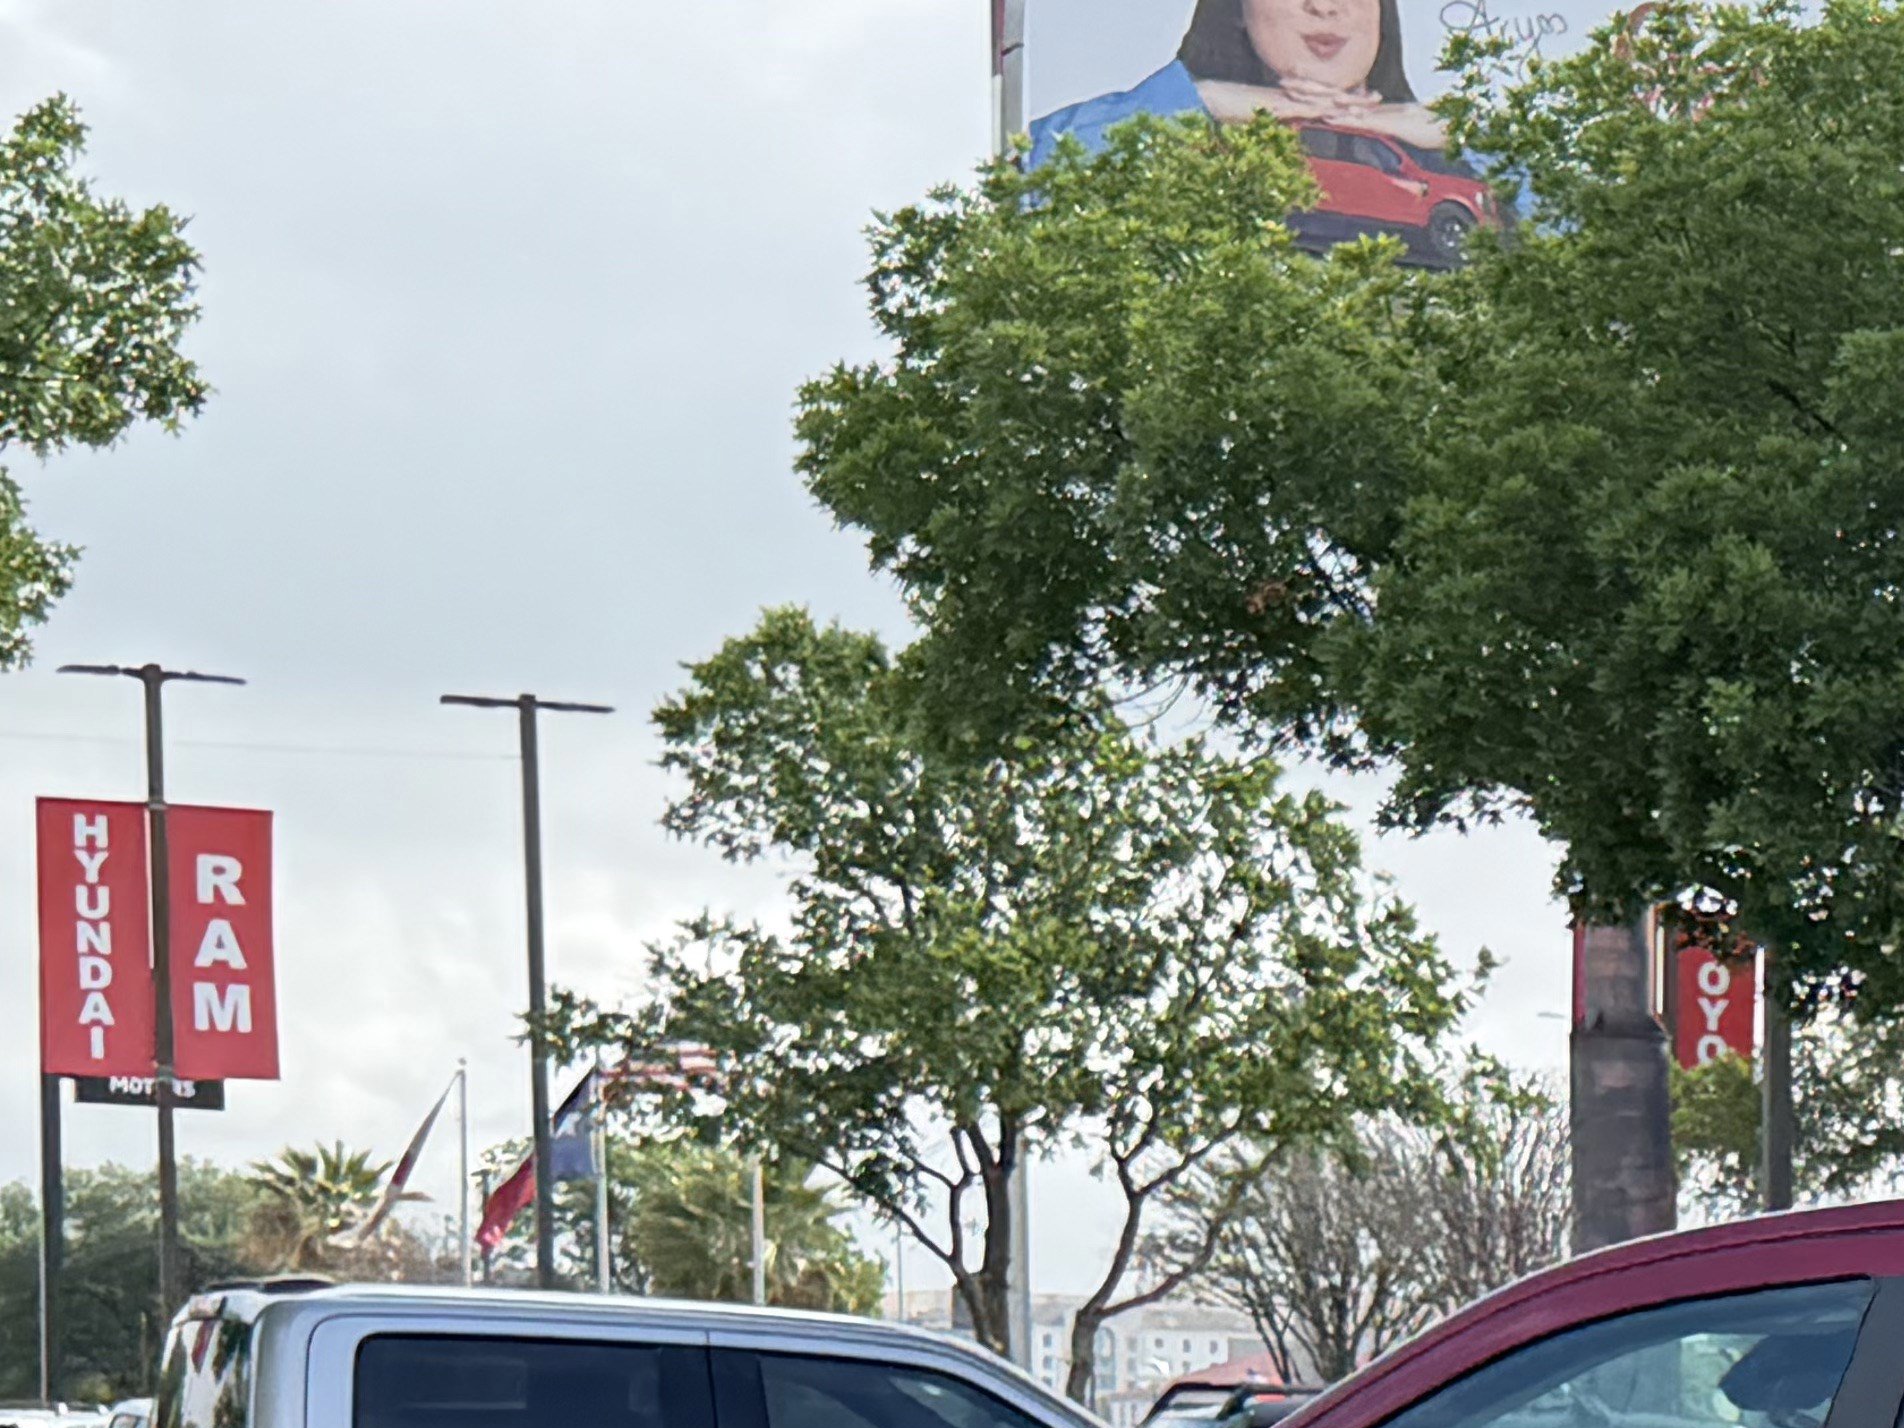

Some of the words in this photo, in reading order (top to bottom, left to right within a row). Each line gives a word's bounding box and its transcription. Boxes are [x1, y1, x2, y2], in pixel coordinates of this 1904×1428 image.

[73, 813, 115, 1060] HYUNDAI
[193, 853, 252, 1033] RAM
[109, 1076, 196, 1098] MOTRS
